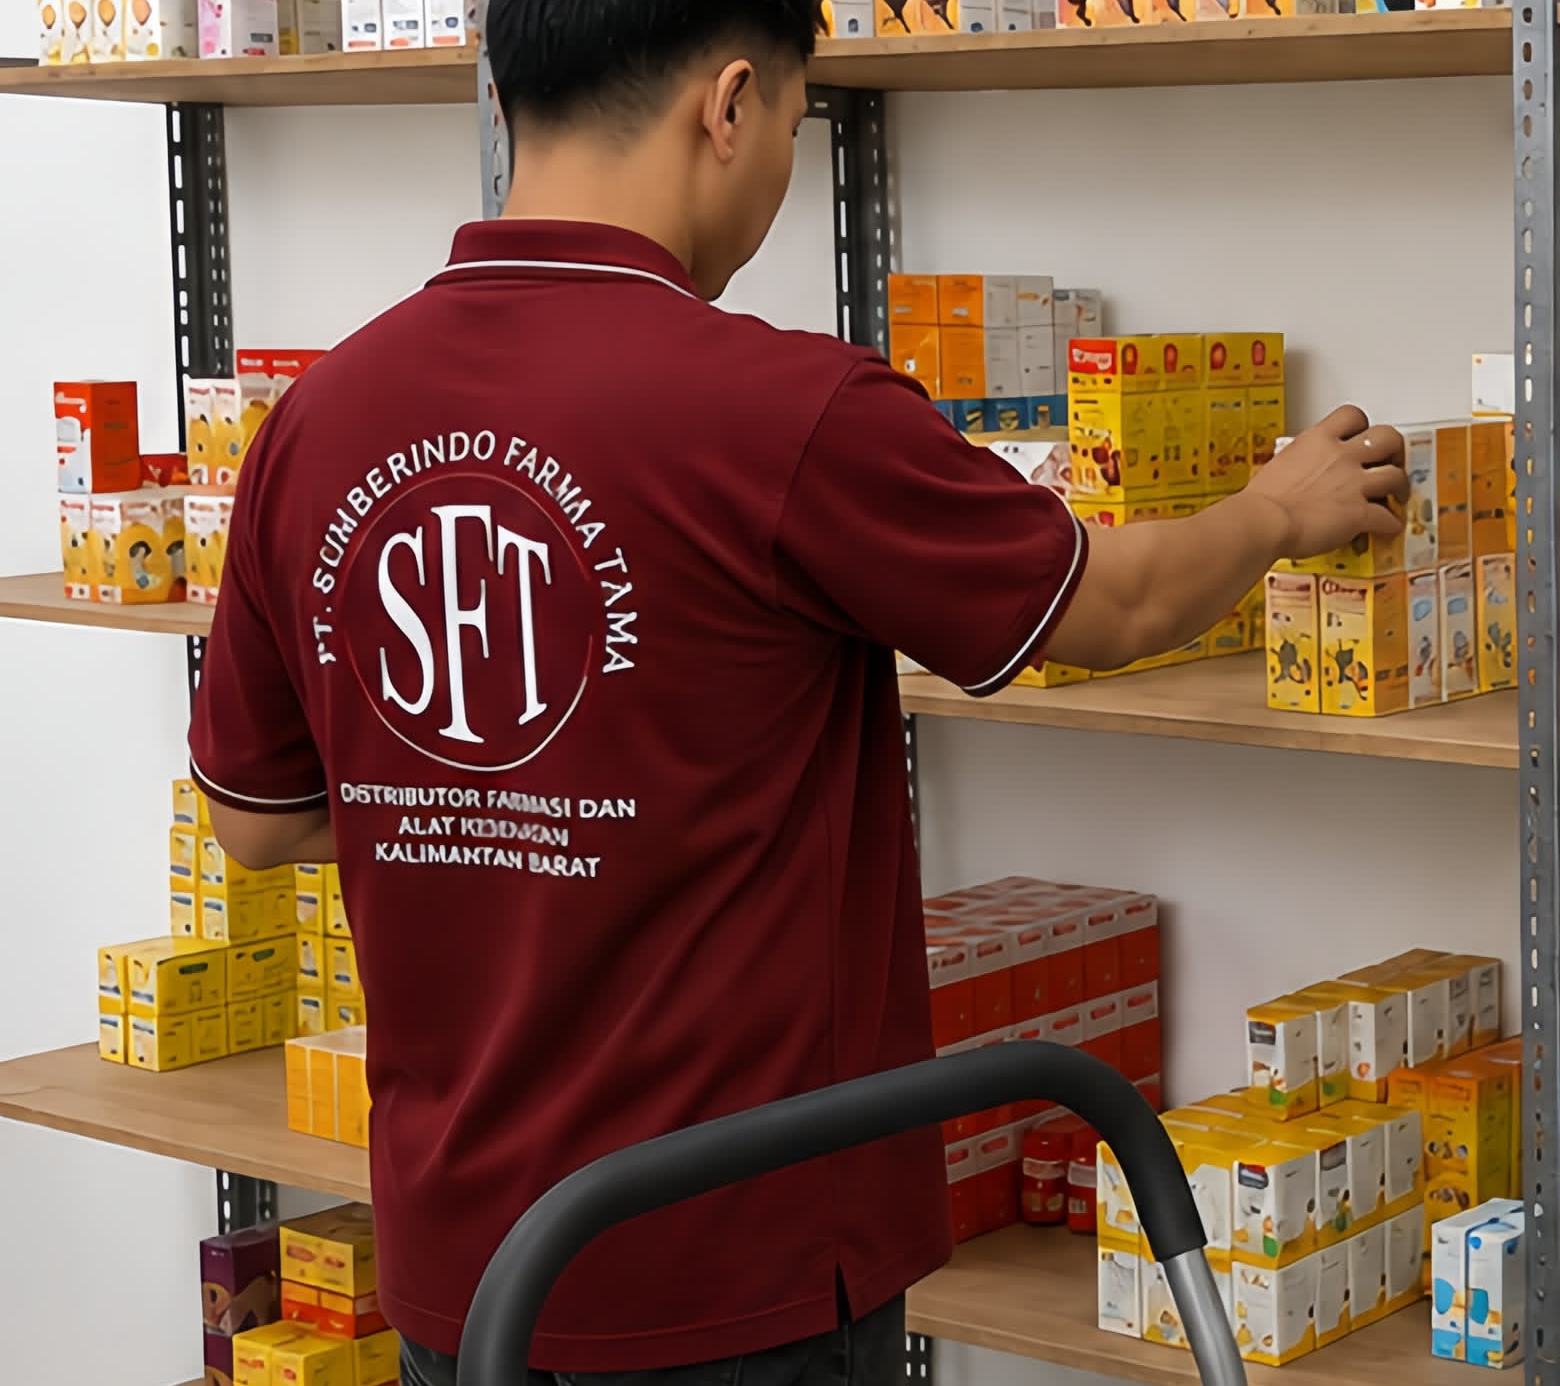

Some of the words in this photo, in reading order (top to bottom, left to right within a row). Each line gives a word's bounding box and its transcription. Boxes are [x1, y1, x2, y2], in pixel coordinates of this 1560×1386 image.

[312, 430, 495, 594] SUMBERINDO
[594, 548, 638, 673] TAMA
[378, 505, 551, 743] SFT
[398, 816, 455, 836] ALAT
[579, 798, 636, 818] DAN
